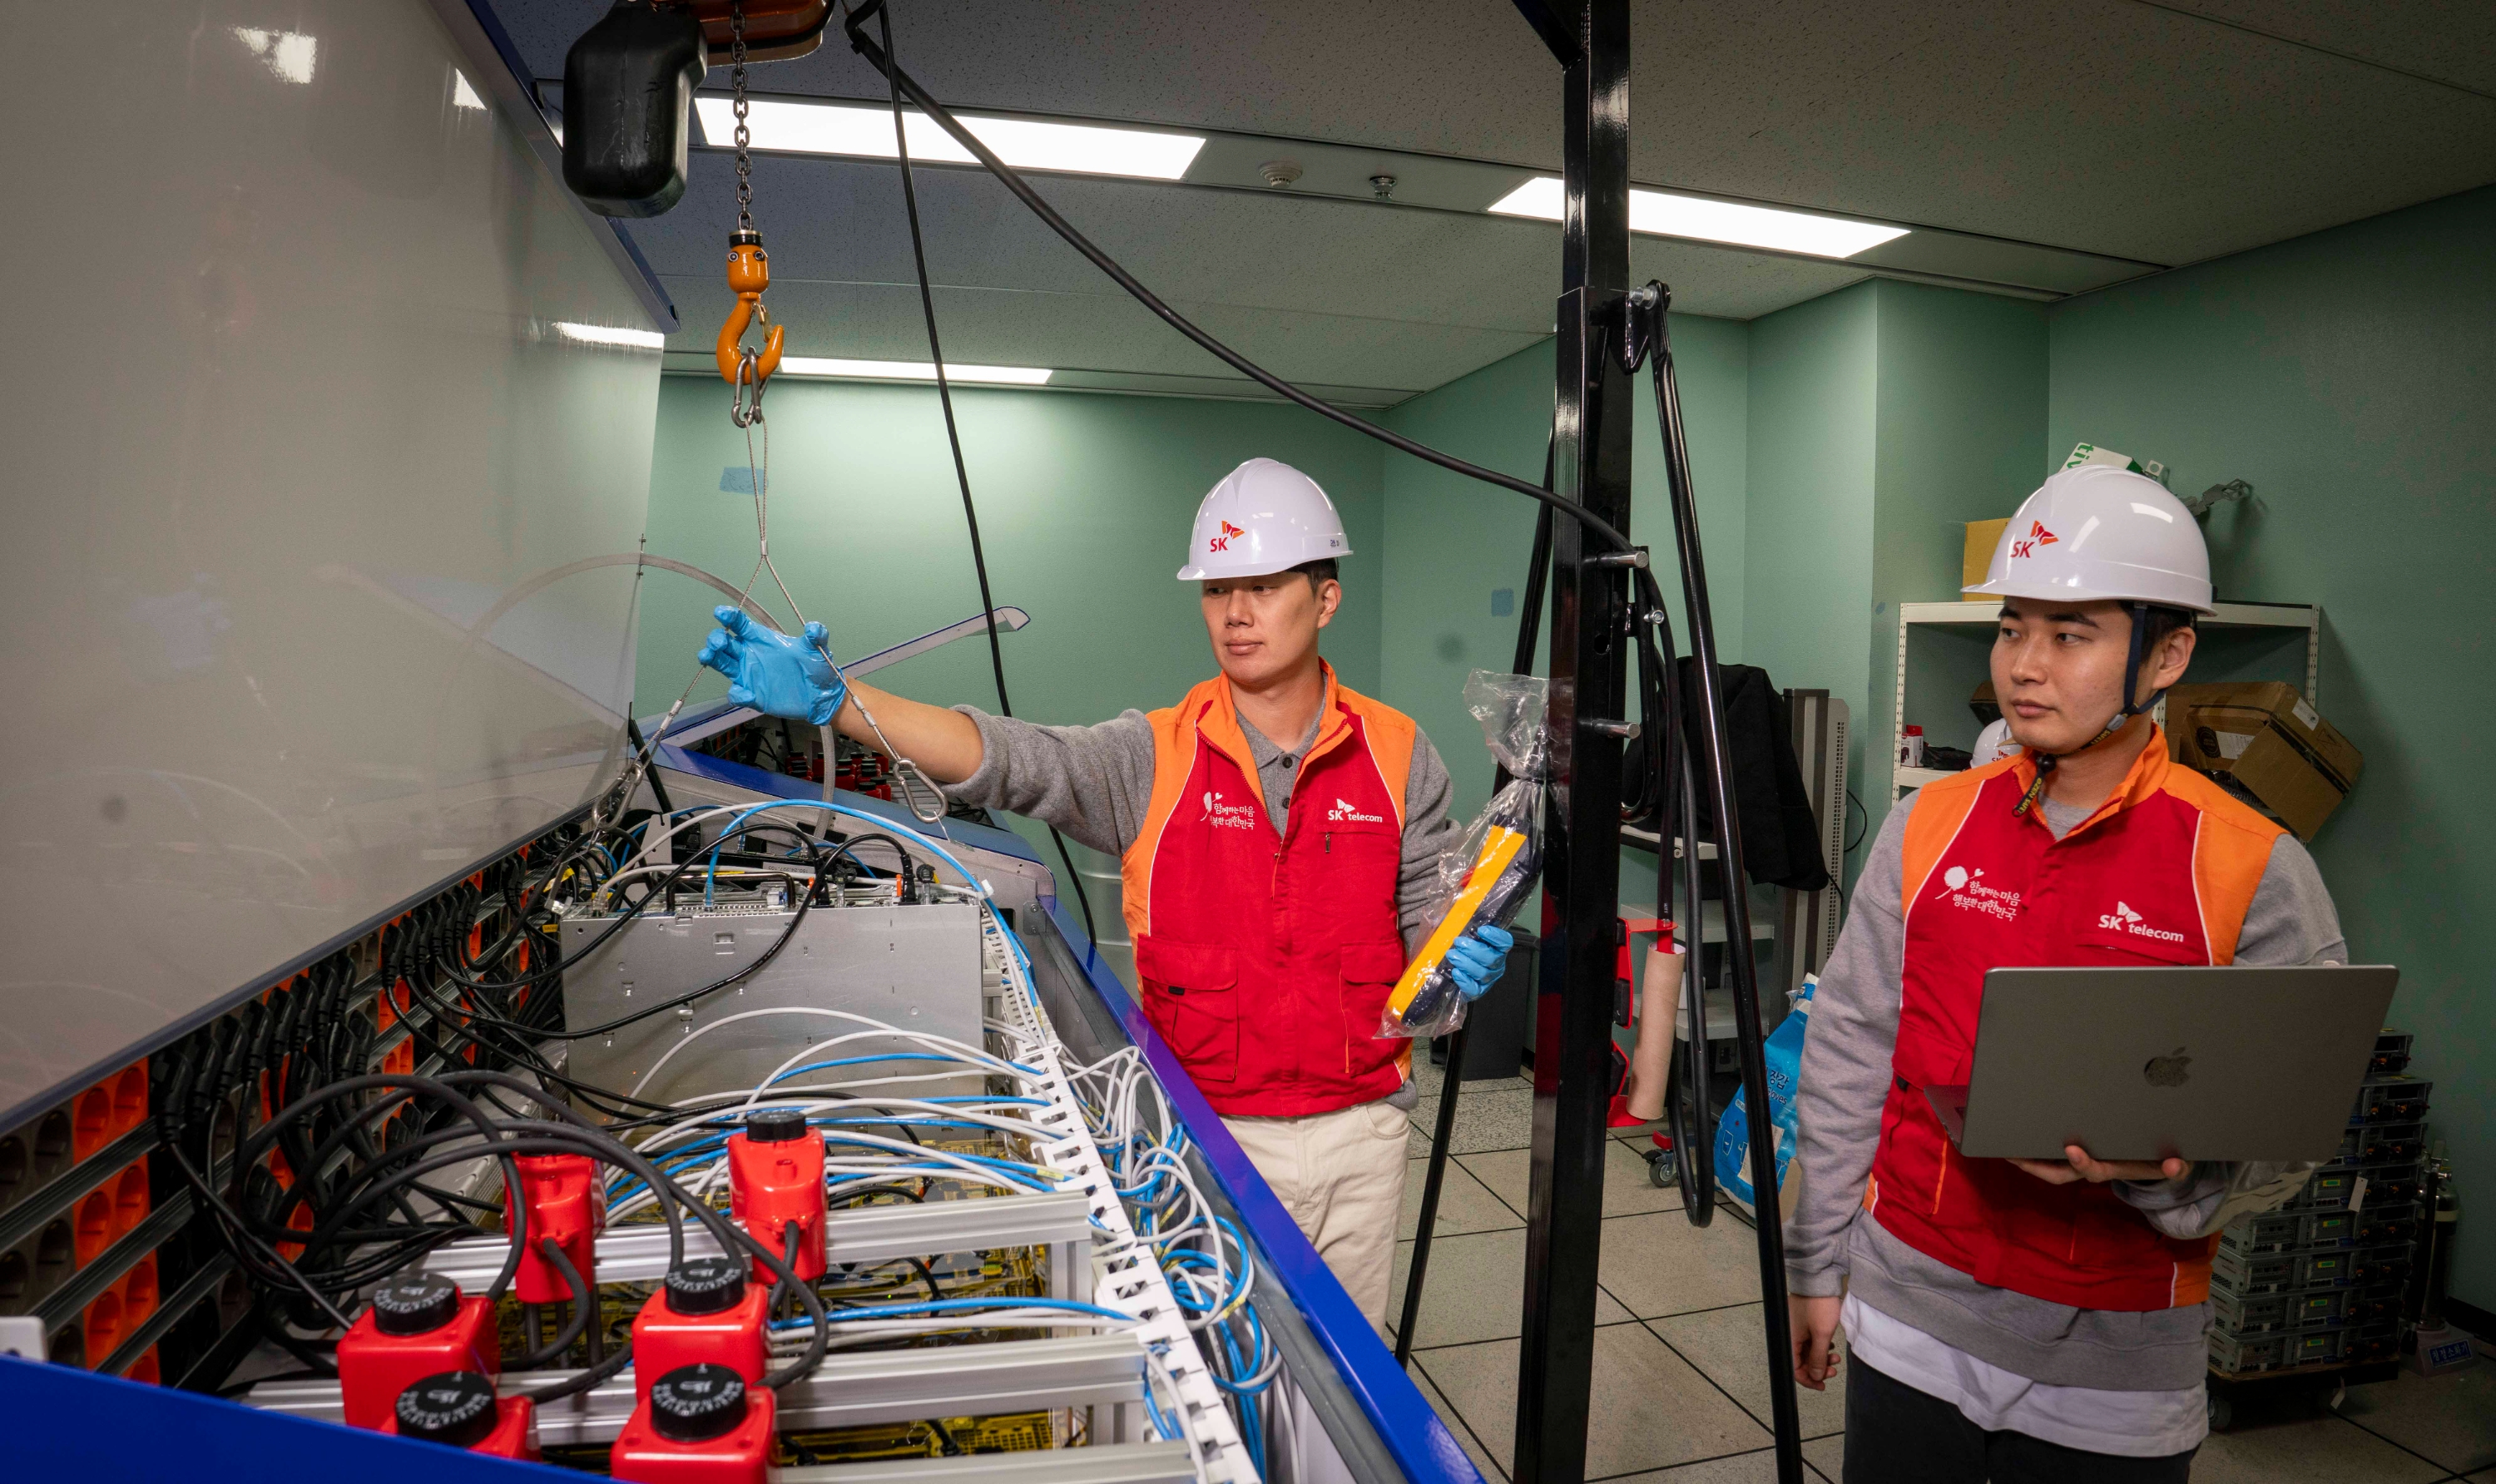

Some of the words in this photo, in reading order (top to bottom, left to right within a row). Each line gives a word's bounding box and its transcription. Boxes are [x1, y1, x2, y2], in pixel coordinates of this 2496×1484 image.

[1210, 537, 1229, 552] SK
[2010, 541, 2035, 558] SK
[1213, 803, 1239, 815] 함께하는
[1239, 805, 1255, 818] 마음
[1328, 809, 1344, 821] SK
[1348, 812, 1383, 823] telecom
[1225, 815, 1255, 830] 대한민국
[1969, 880, 2000, 898] 함께하는
[2000, 891, 2022, 907] 마음
[1953, 893, 1978, 911] 행복한
[1977, 899, 2017, 923] 대한민국
[2097, 914, 2124, 931] SK
[2128, 923, 2184, 942] telecom
[1770, 1070, 1789, 1090] 장갑
